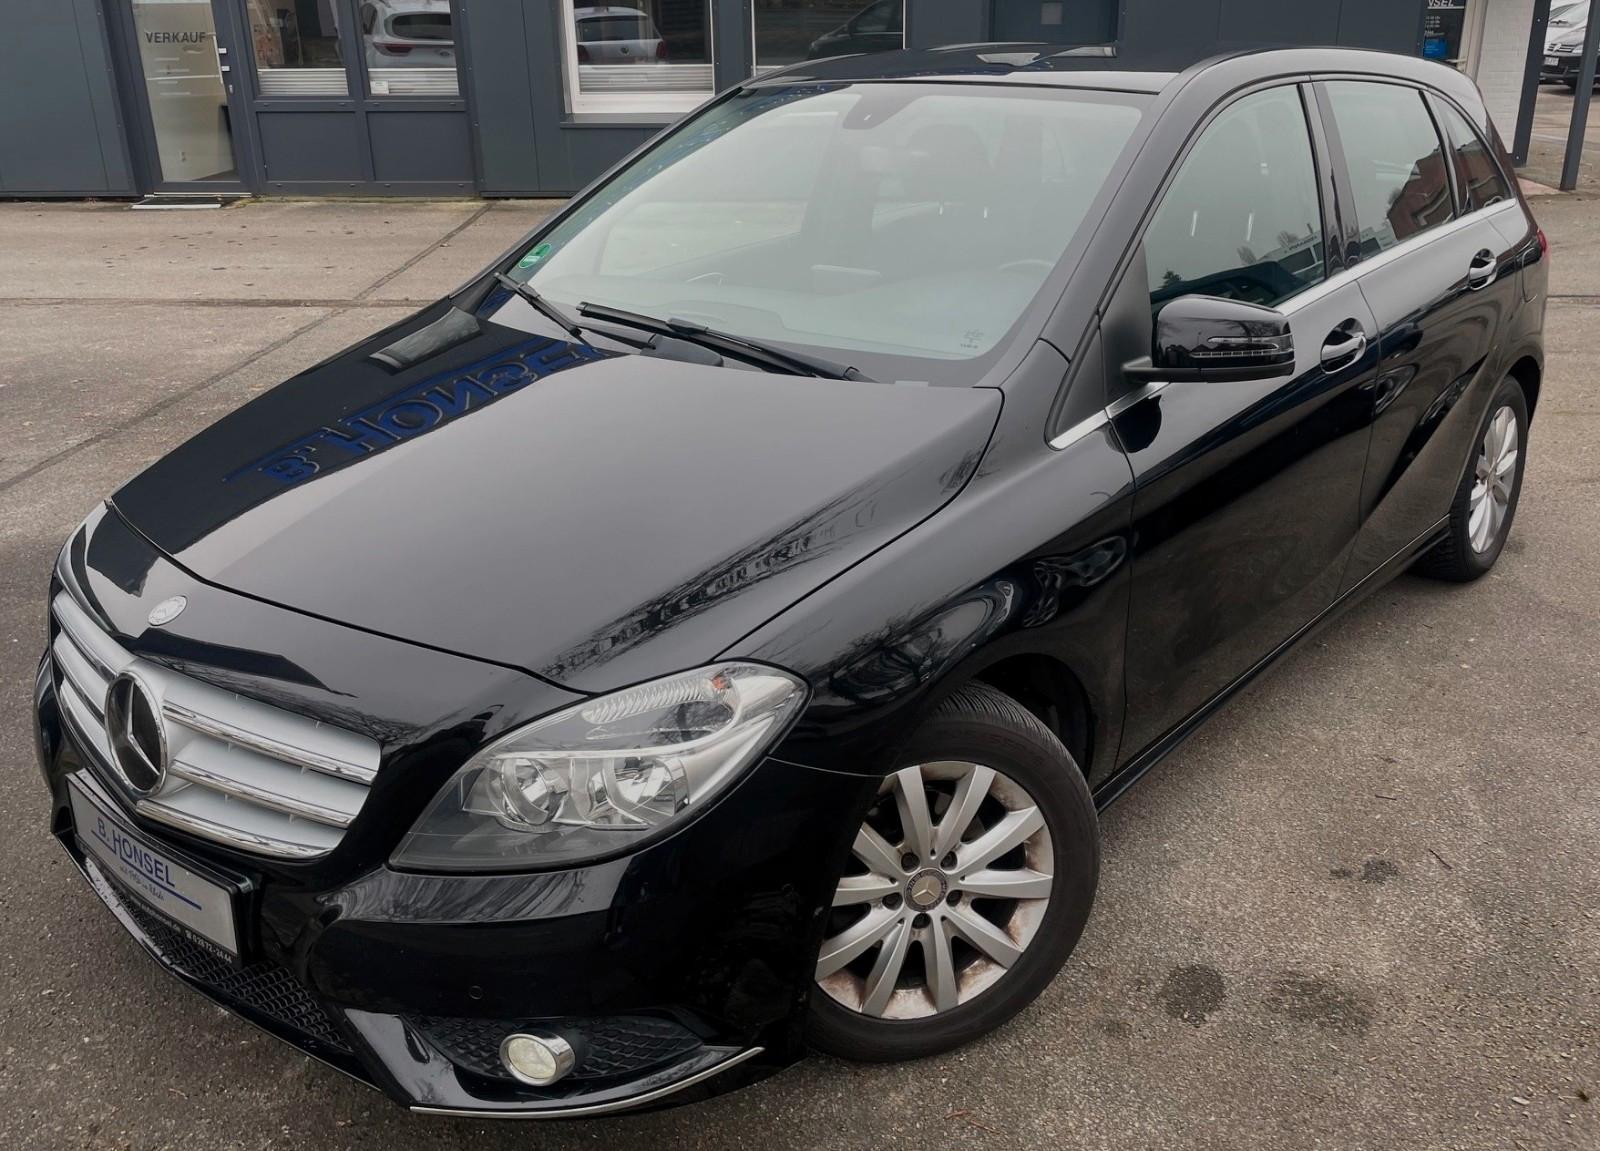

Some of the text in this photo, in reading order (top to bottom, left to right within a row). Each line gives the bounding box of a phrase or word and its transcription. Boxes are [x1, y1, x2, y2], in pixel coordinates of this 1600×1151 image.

[145, 31, 206, 44] VERKAUF
[97, 816, 110, 841] B.
[112, 831, 175, 888] HONSEL
